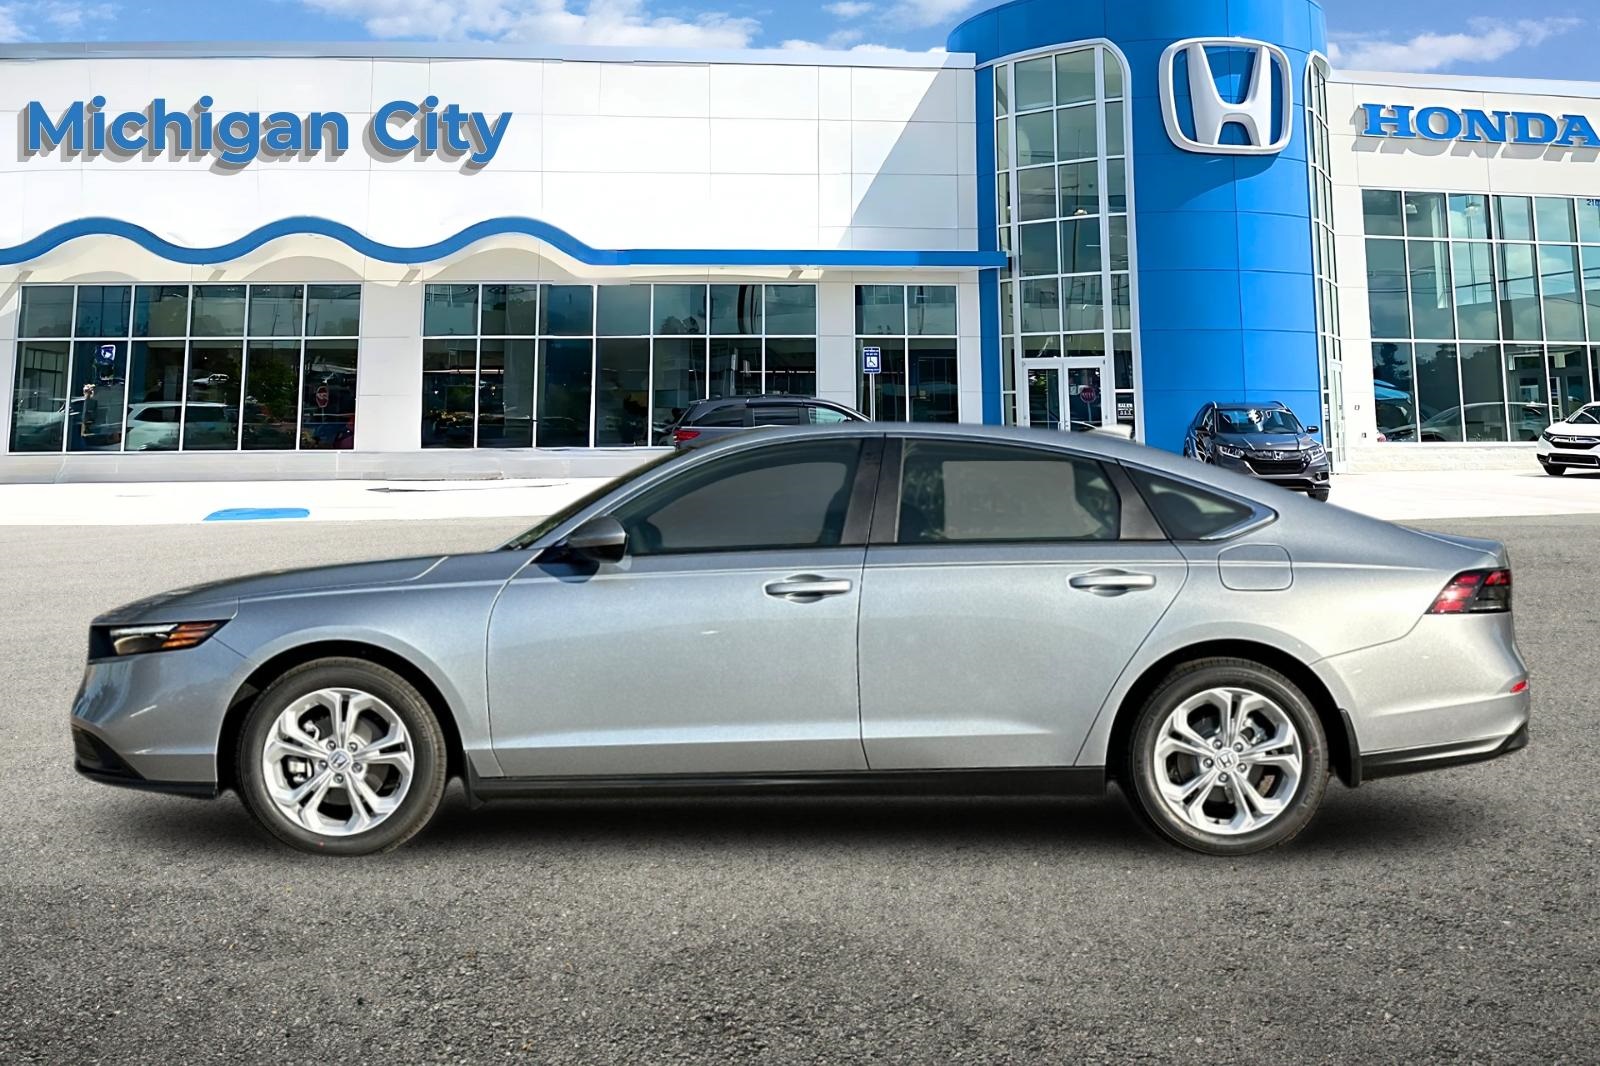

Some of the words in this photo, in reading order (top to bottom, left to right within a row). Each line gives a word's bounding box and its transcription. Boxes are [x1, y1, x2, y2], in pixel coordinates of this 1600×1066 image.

[29, 95, 349, 164] Michigan
[374, 95, 513, 164] City
[1362, 103, 1600, 148] HONDA
